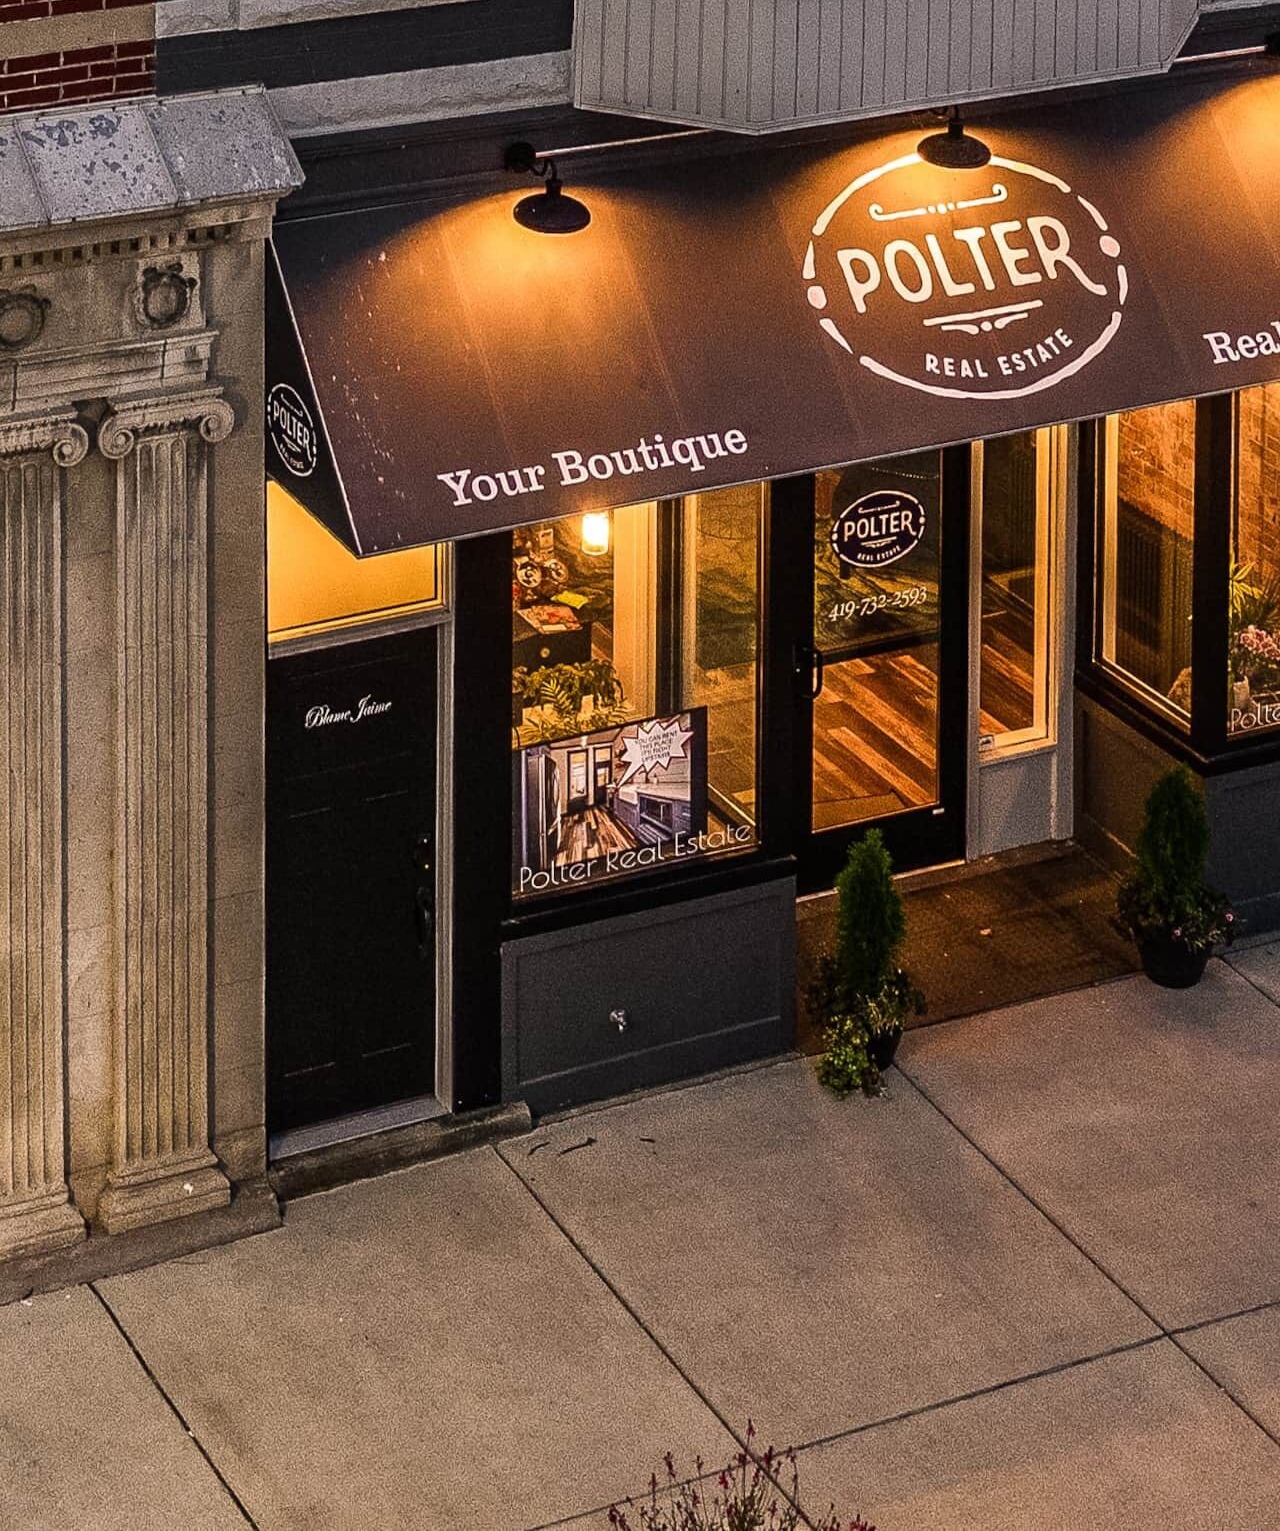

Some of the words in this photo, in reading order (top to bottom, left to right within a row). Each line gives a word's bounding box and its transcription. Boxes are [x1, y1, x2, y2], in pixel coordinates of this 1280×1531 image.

[836, 215, 1108, 313] POLTER
[925, 353, 989, 378] REAL
[997, 328, 1074, 376] ESTATE
[273, 400, 313, 462] POLTER
[437, 464, 545, 506] Your
[552, 428, 748, 486] Boutique
[844, 510, 917, 542] POLTER
[828, 586, 928, 622] 419-732-2593
[520, 860, 597, 892] Polter
[606, 837, 665, 872] Real
[675, 823, 751, 857] Estate
